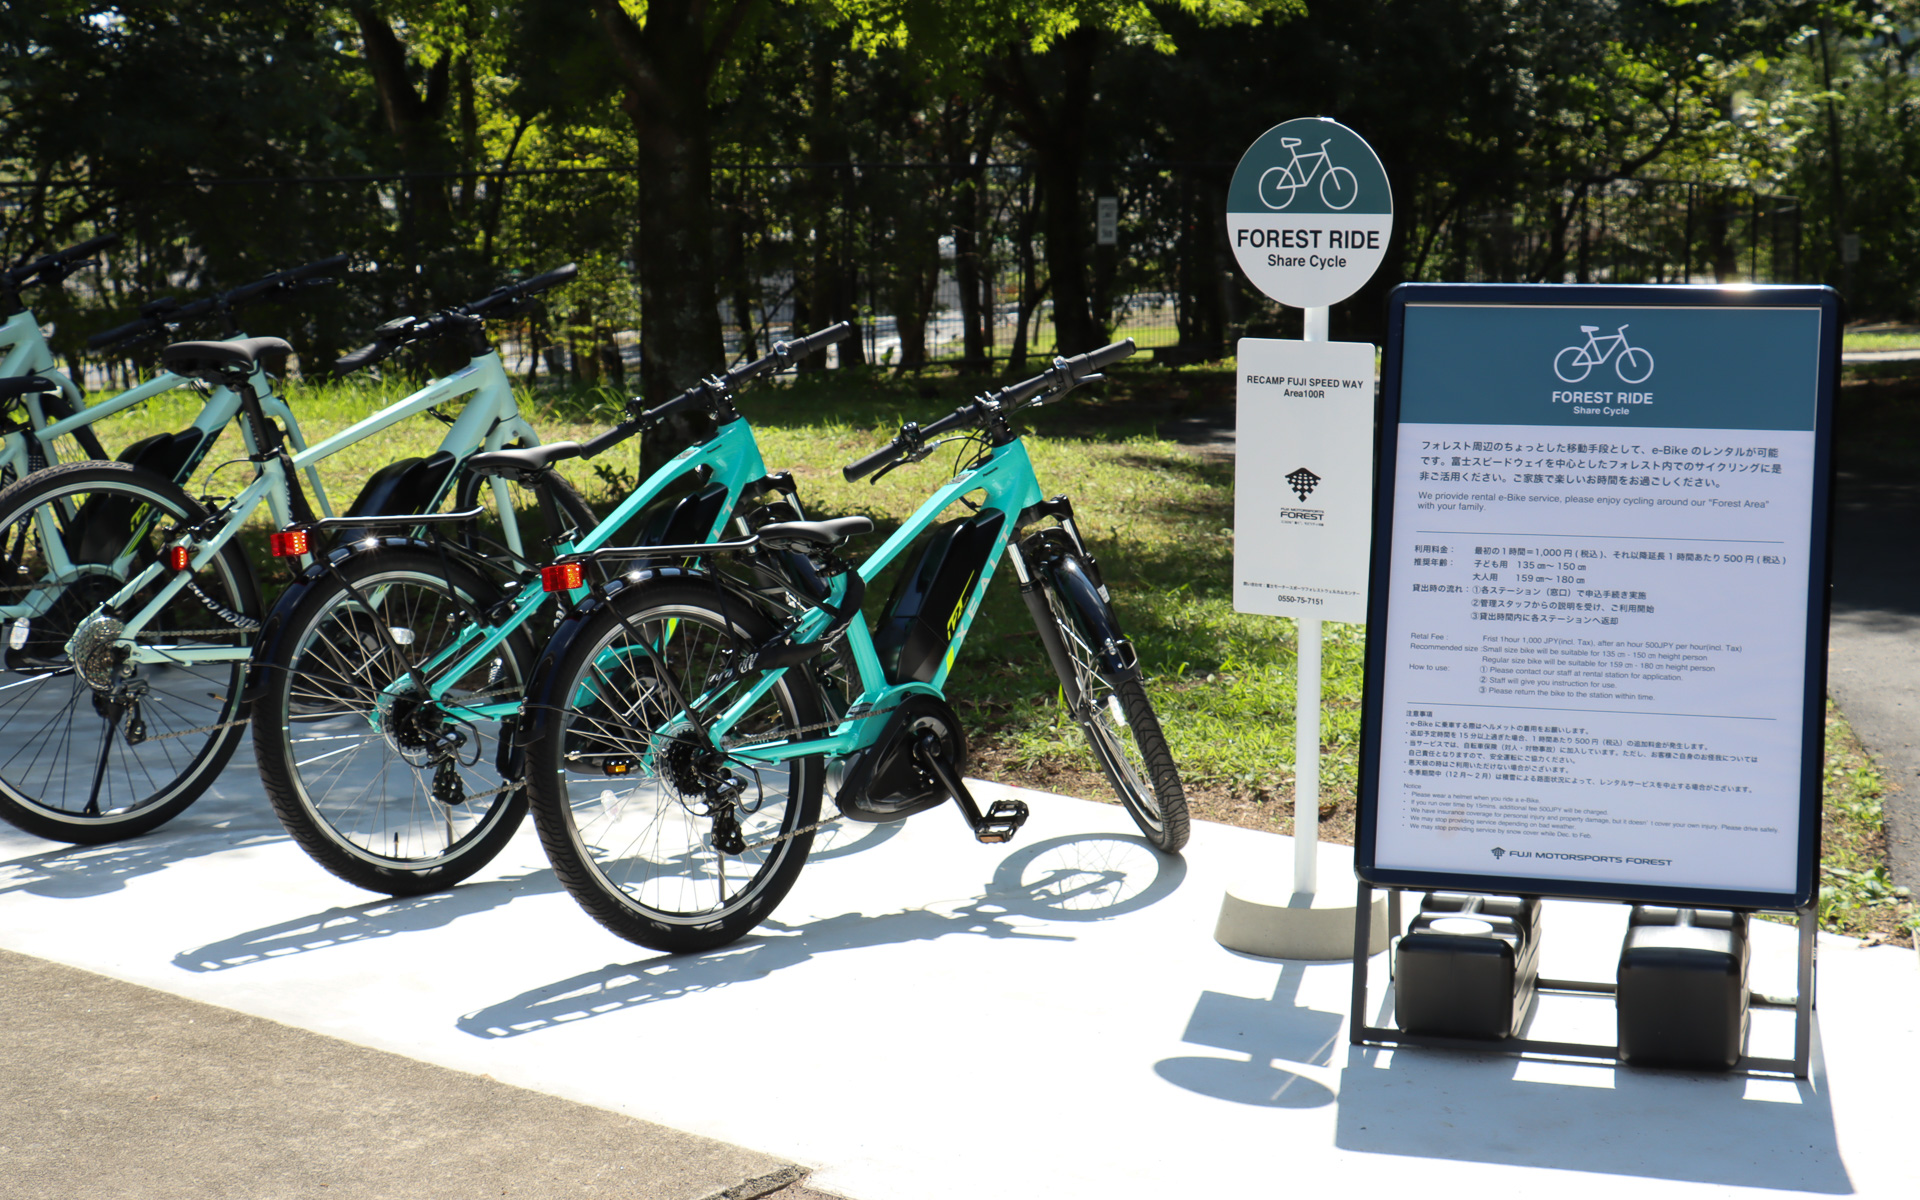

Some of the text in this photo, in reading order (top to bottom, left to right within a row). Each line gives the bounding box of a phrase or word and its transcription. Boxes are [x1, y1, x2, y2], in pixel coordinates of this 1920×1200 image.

[1237, 229, 1380, 250] FOREST RIDE
[1268, 254, 1347, 270] Share Cycle
[1246, 375, 1364, 389] RECAMP FUJI SPEED WAY
[1284, 388, 1325, 399] Area100R
[1552, 390, 1653, 404] FOREST RIDE
[1573, 406, 1629, 416] Share Cycle
[1418, 491, 1432, 499] We
[1471, 492, 1495, 500] rental
[1498, 493, 1526, 502] e-Bike
[1528, 494, 1562, 503] service,
[1564, 495, 1594, 504] please
[1596, 495, 1620, 505] enjoy
[1622, 496, 1654, 507] cycling
[1656, 497, 1688, 506] around
[1708, 498, 1741, 507] "Forest
[1743, 499, 1769, 508] Area"
[1417, 501, 1485, 512] with your family.
[1280, 511, 1324, 520] FOREST
[1472, 572, 1498, 581] 大人用
[1278, 595, 1324, 605] 0550-75-7151
[1410, 642, 1462, 651] Recommended
[1645, 641, 1673, 649] 500JPY
[1725, 644, 1742, 653] Tax)
[1482, 645, 1502, 653] Small
[1658, 652, 1680, 661] height
[1481, 655, 1509, 664] Regular
[1665, 663, 1688, 672] height
[1689, 665, 1715, 673] person
[1488, 686, 1512, 694] Please
[1509, 850, 1672, 866] FUJI MOTORSPORTS FOREST
